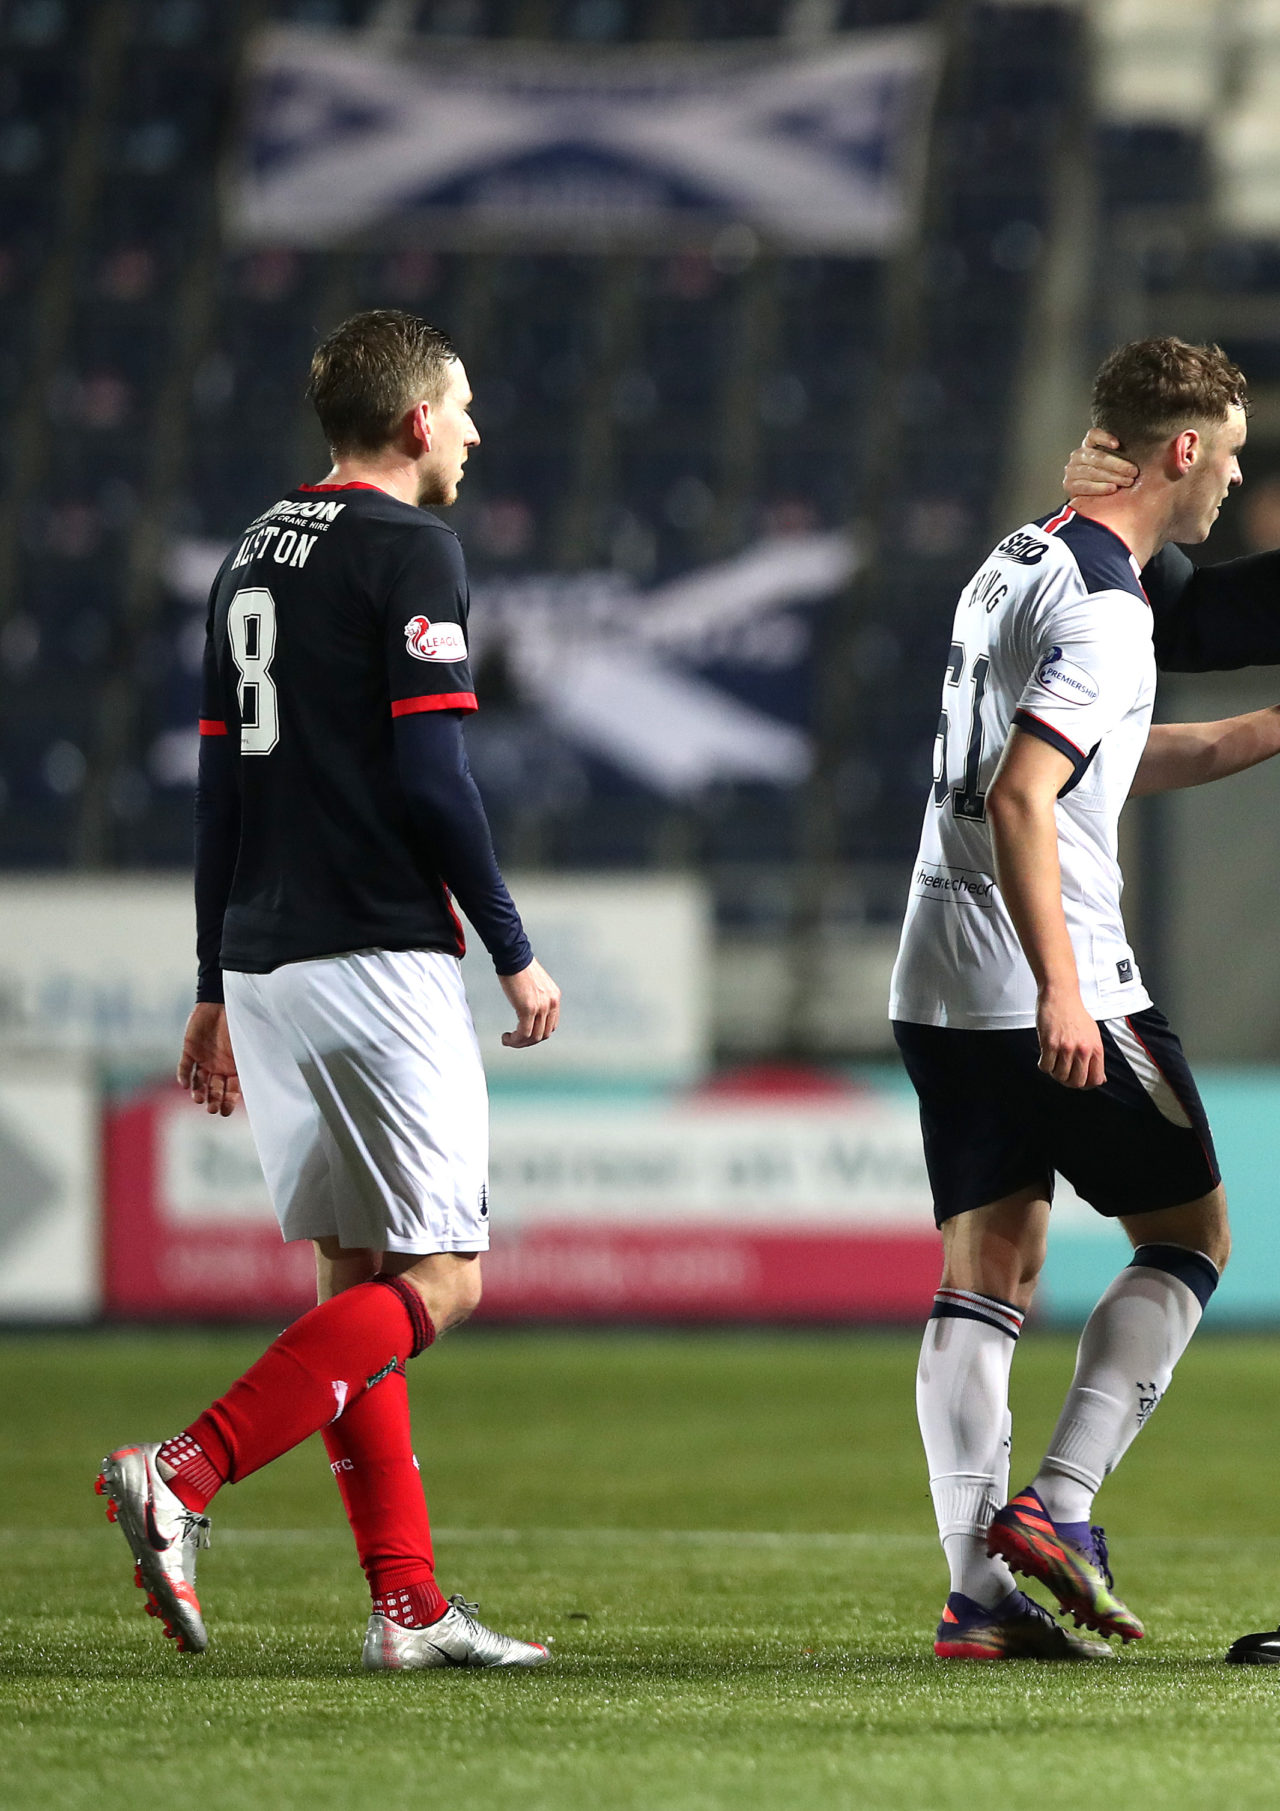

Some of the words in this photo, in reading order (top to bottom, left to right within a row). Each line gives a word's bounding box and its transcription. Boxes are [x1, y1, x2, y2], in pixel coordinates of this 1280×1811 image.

[309, 520, 330, 533] HIRE
[231, 526, 319, 571] ALSTON
[227, 586, 279, 755] 8
[1046, 667, 1097, 699] PREMIERSHIP
